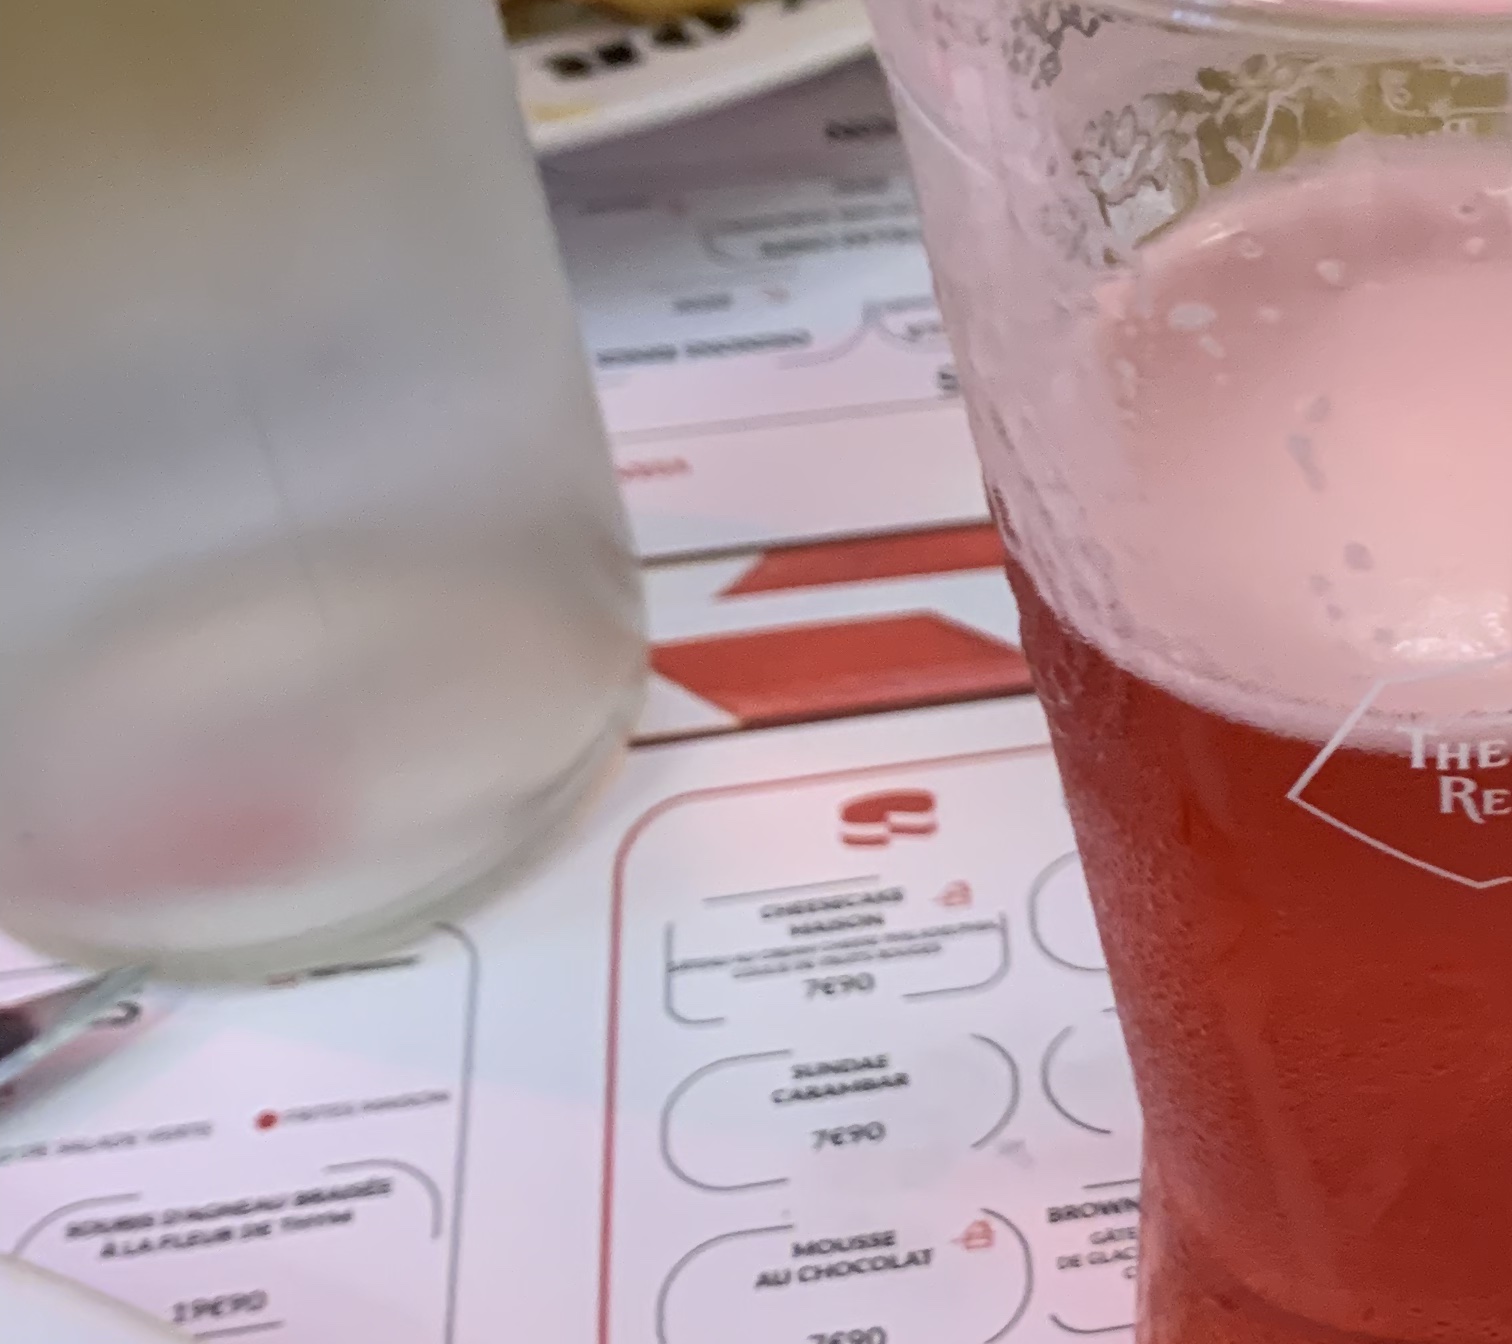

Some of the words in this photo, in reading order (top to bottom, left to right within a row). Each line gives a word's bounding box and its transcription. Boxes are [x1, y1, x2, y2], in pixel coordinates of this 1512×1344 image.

[1397, 724, 1511, 771] THE
[811, 1120, 886, 1151] 7€90
[792, 1229, 896, 1258] MOUSSE
[754, 1266, 791, 1290] AU
[798, 1248, 934, 1283] CHOCOLAT
